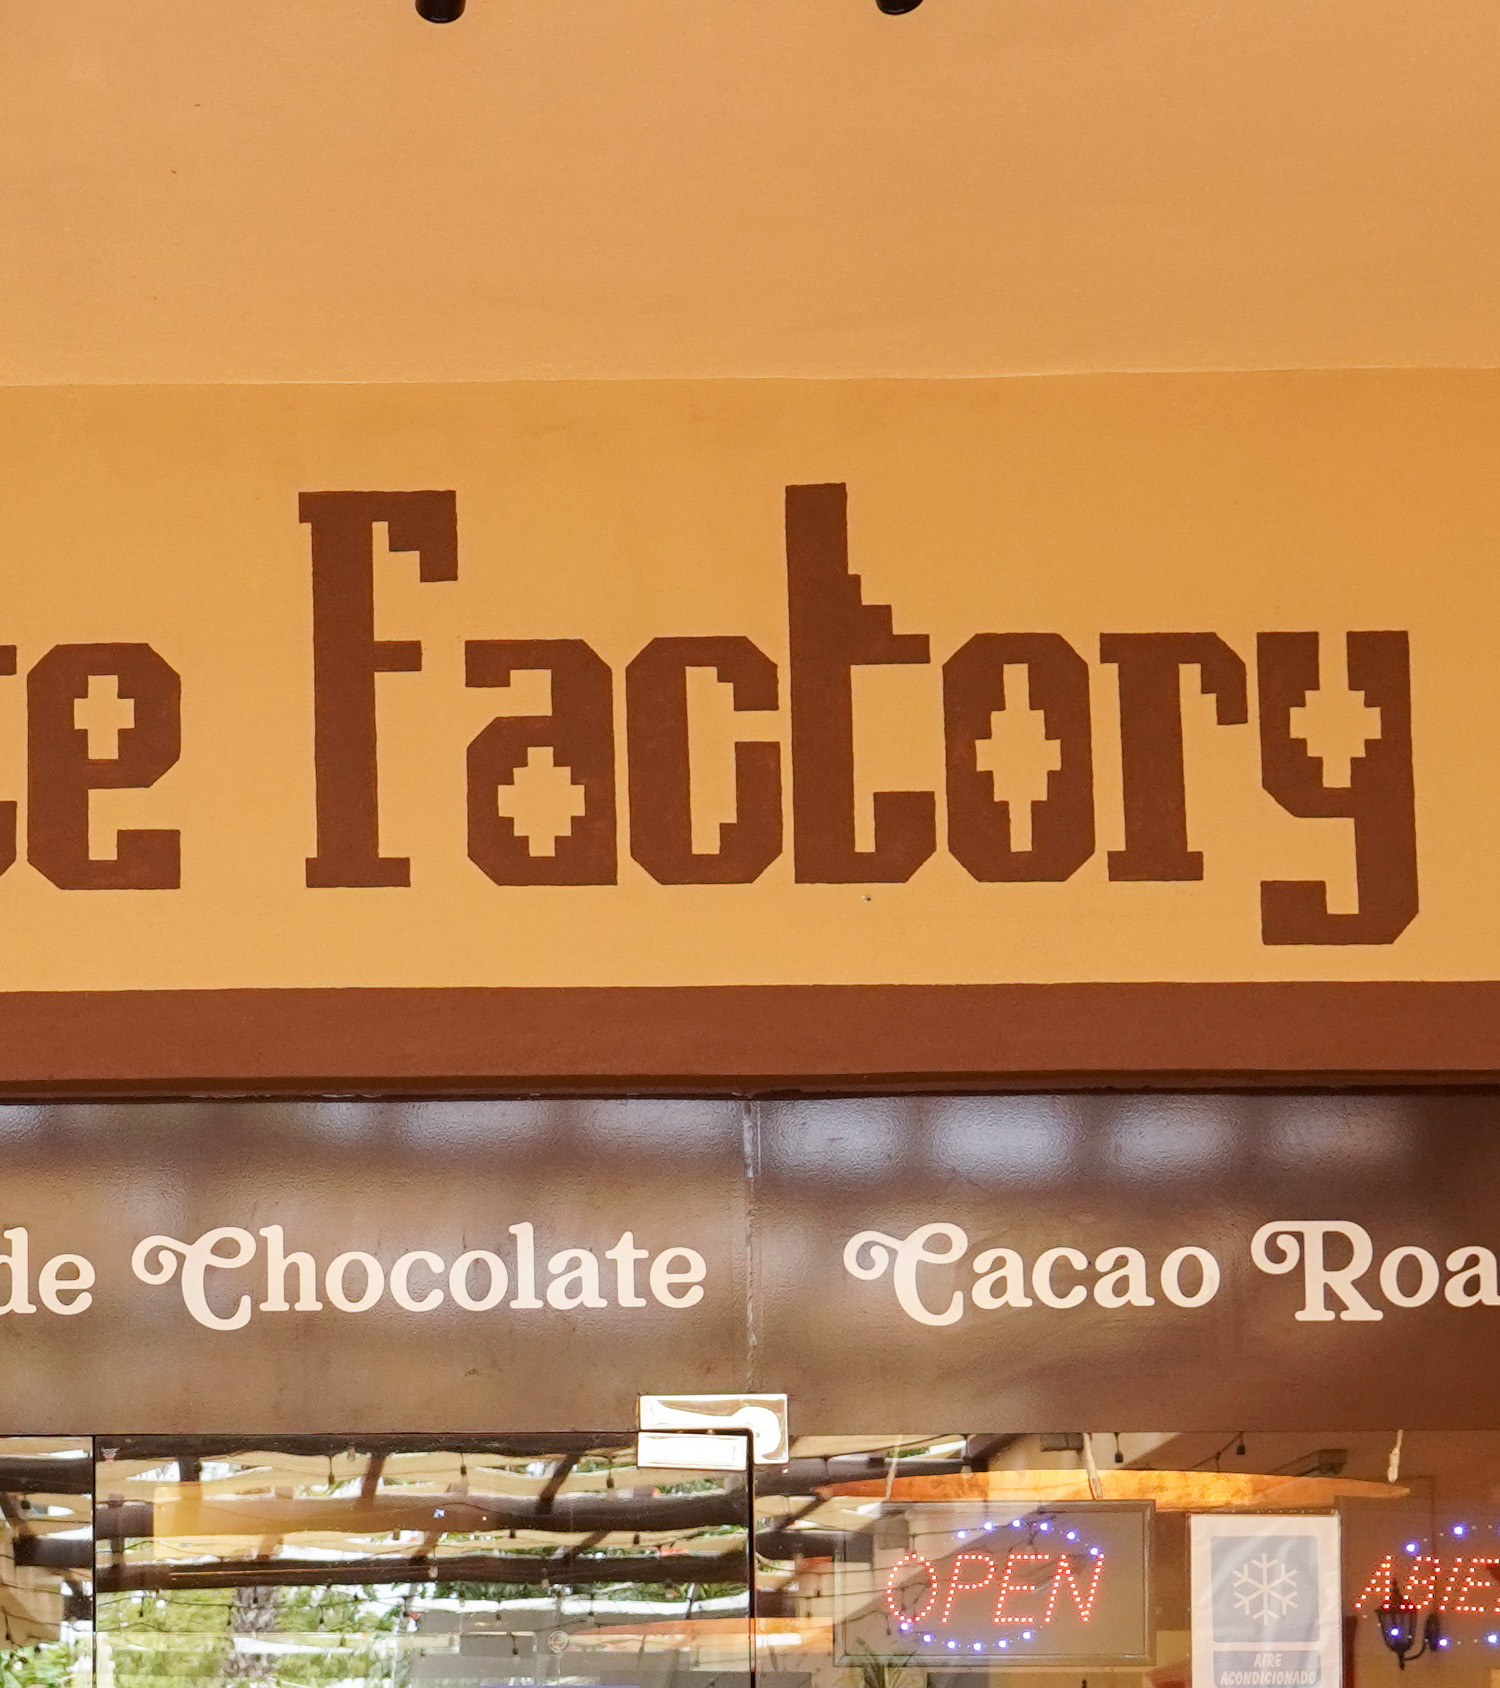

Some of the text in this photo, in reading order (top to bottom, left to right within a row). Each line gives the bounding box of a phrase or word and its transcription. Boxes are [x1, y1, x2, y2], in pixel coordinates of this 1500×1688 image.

[299, 481, 1420, 946] Factory
[131, 1221, 707, 1331] Chocolate
[842, 1222, 1220, 1327] Cacao
[885, 1552, 1106, 1623] OPEN
[1219, 1670, 1317, 1686] ACONDICIONADO
[1253, 1652, 1283, 1668] AIRE
